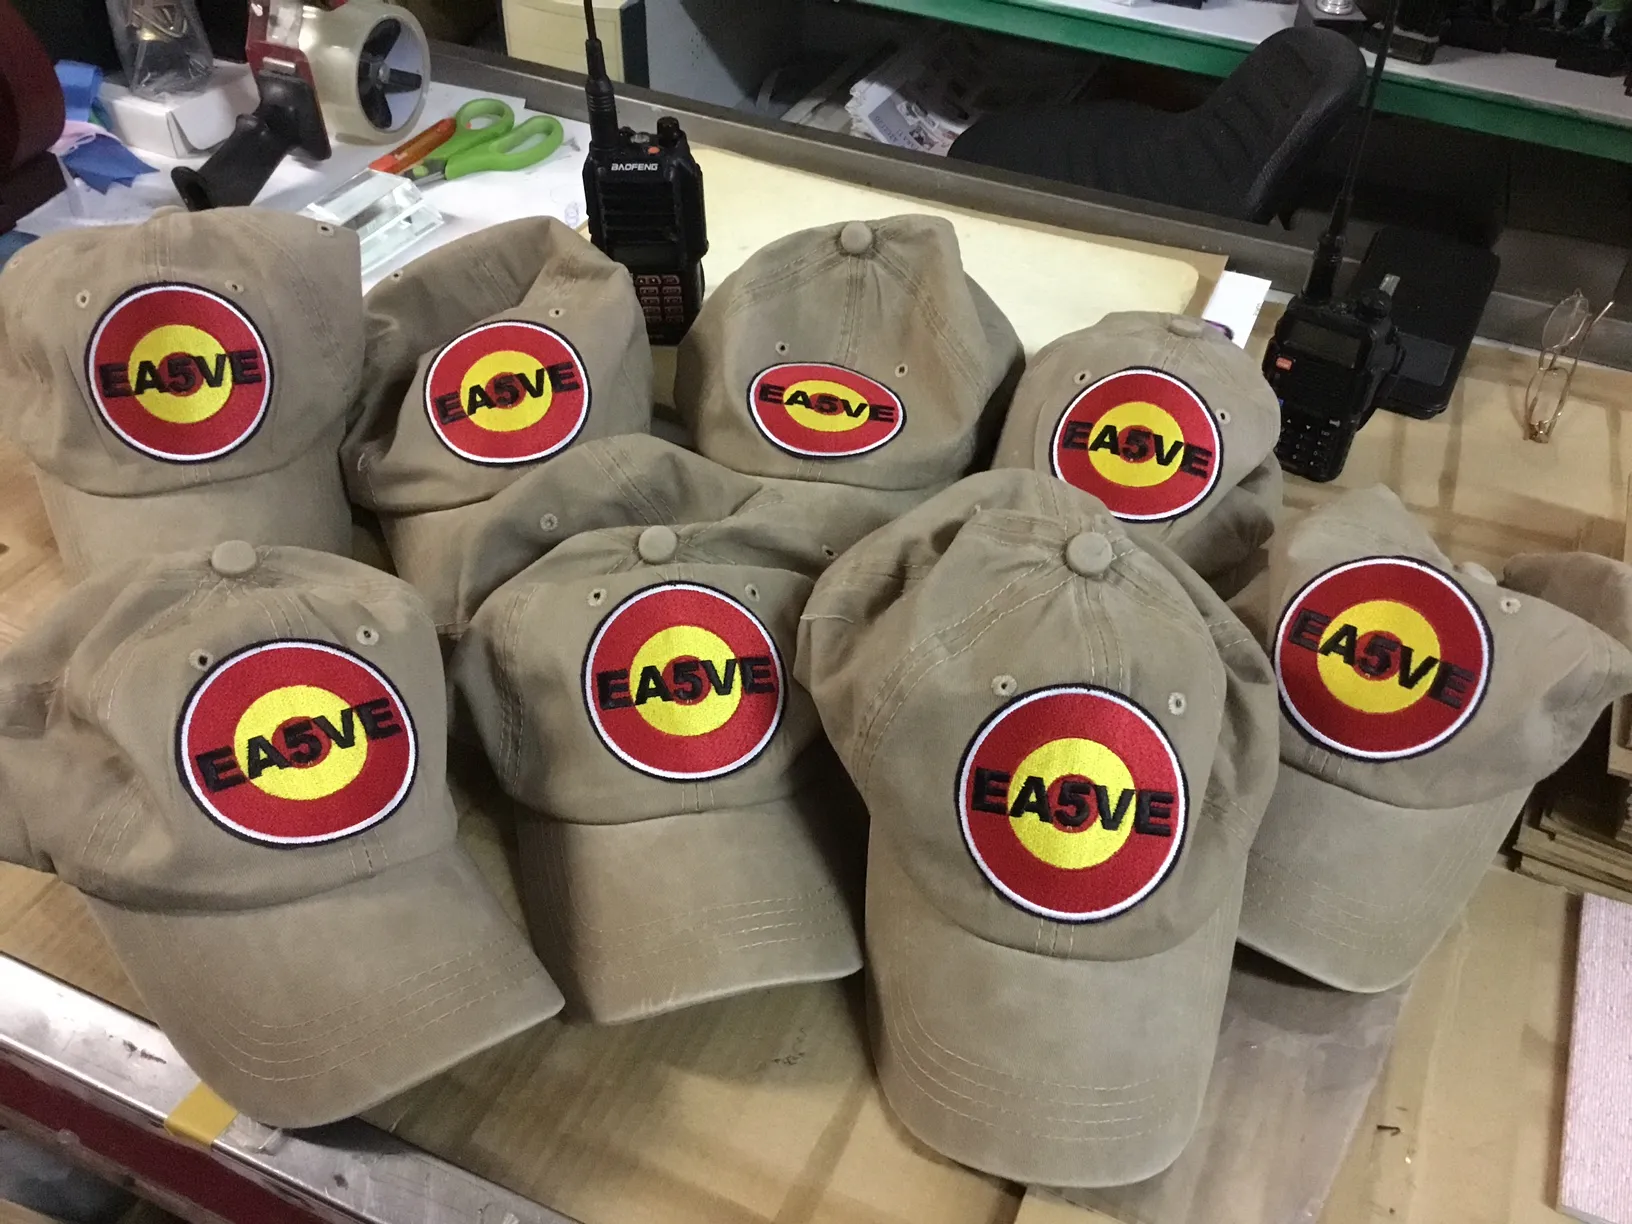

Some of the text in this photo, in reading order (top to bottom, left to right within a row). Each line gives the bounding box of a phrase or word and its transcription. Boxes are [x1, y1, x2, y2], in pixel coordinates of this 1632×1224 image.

[611, 162, 659, 171] BAOFENG
[99, 349, 262, 398] EA5VE
[435, 361, 580, 425] EA5VE
[759, 383, 895, 423] EA5VE
[1062, 420, 1213, 479] EA5VE
[596, 656, 776, 711] EA5VE
[1288, 607, 1475, 710] EA5VE
[195, 697, 401, 793] EA5VE
[971, 767, 1174, 837] EA5VE
